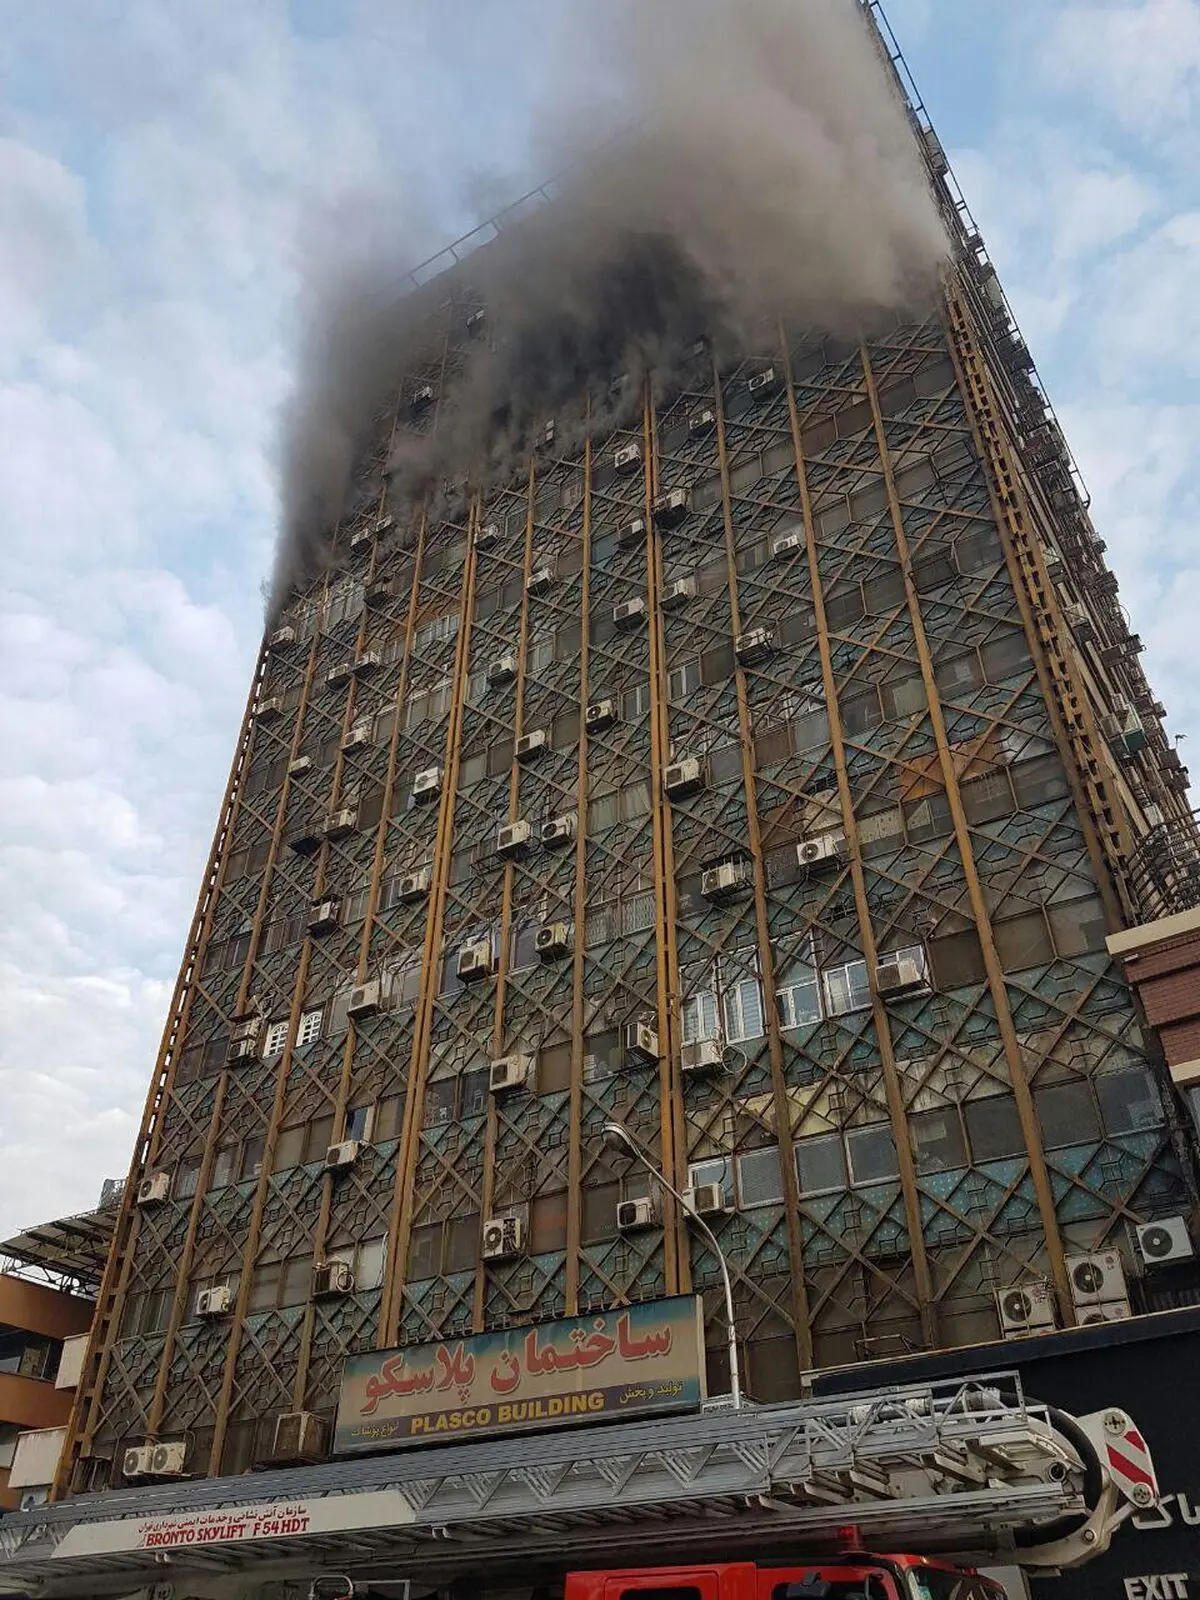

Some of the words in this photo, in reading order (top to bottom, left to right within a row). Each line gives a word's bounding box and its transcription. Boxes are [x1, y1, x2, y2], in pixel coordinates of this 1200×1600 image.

[489, 1312, 673, 1395] ساختمان
[359, 1341, 476, 1416] پلاسکو
[648, 1387, 655, 1399] و
[410, 1408, 492, 1435] PLASCO
[498, 1393, 605, 1425] BUILDING
[233, 1508, 258, 1523] نشانی
[258, 1505, 278, 1521] آتش
[277, 1504, 307, 1519] سازمان
[146, 1529, 195, 1547] BRONTO
[197, 1523, 247, 1542] SKYLIFT
[1123, 1572, 1189, 1600] EXIT
